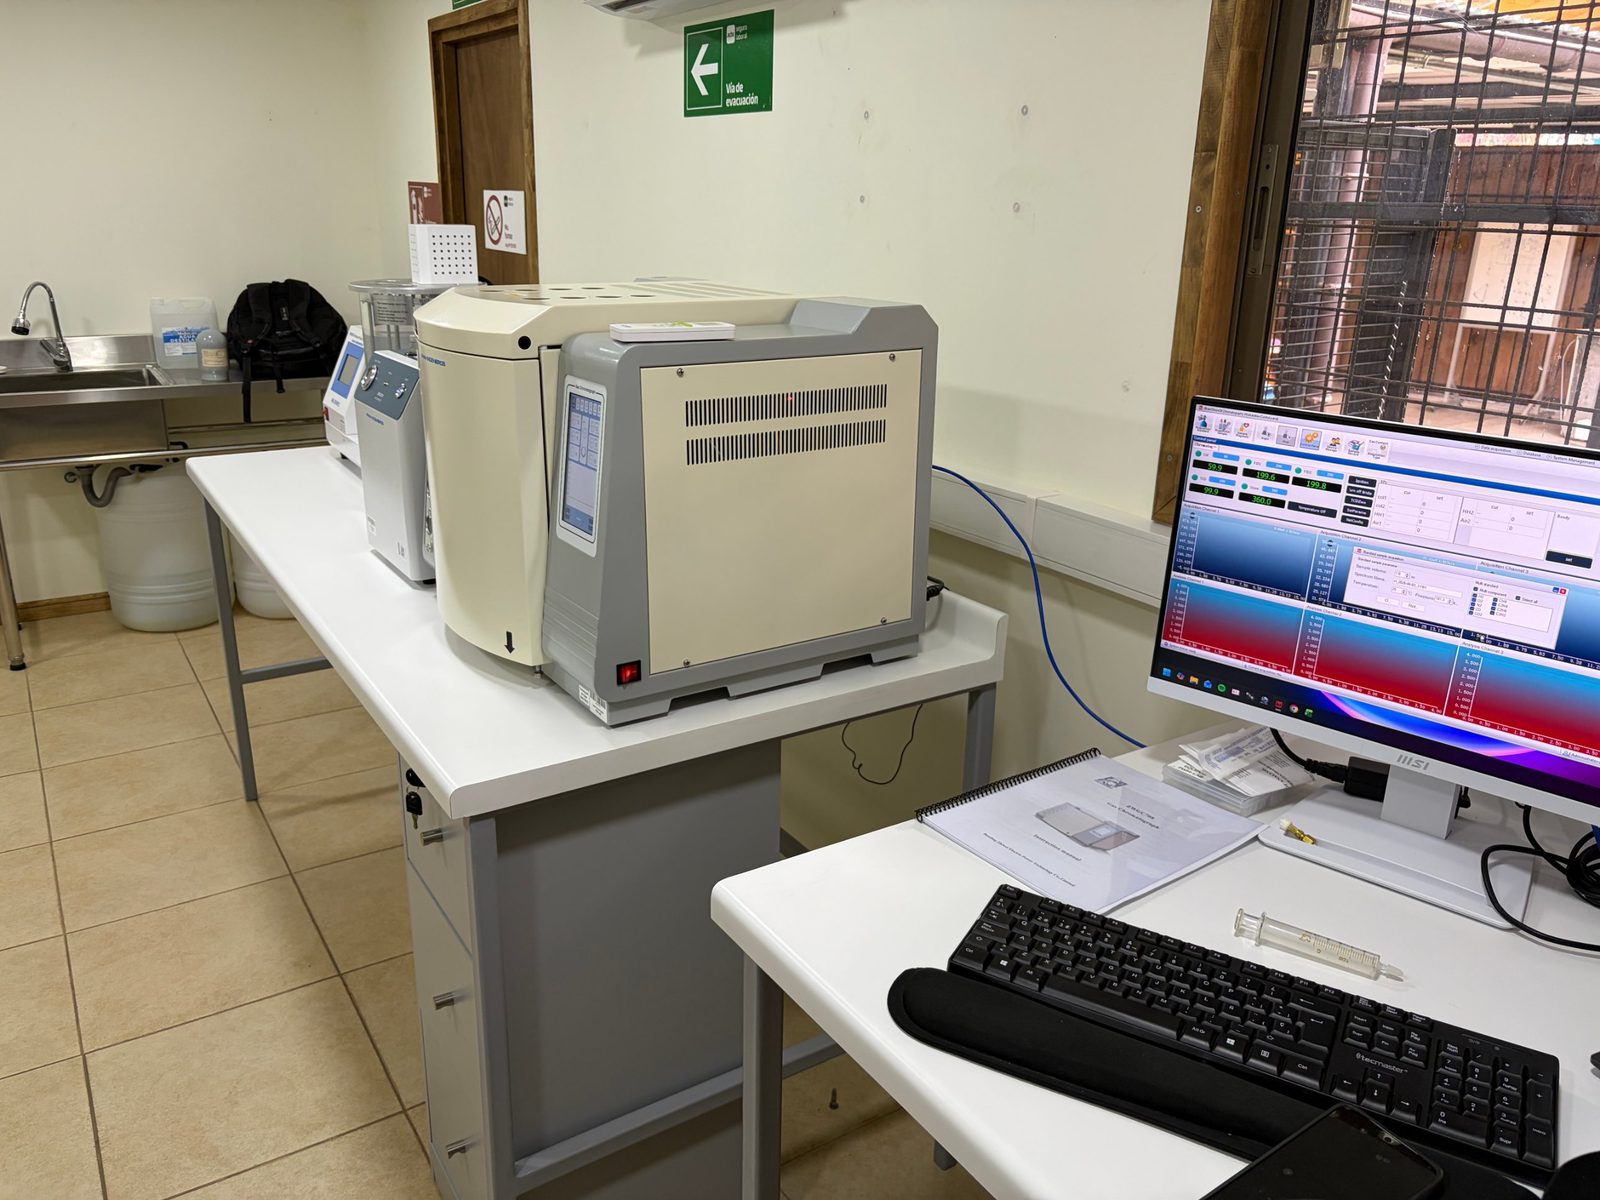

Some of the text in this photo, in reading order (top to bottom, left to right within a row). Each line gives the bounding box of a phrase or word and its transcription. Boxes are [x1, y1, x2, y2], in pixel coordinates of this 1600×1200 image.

[726, 82, 744, 94] Vía de
[726, 93, 758, 107] evacuación
[1208, 462, 1222, 472] 59.9
[1256, 472, 1276, 480] 199.6
[1306, 480, 1327, 490] 199.8
[1204, 487, 1219, 496] 99.9
[1252, 496, 1272, 504] 360.0
[1480, 560, 1504, 570] Acquisition
[1505, 565, 1524, 573] Channel
[1480, 645, 1500, 653] Channel
[1360, 1054, 1404, 1074] tecmaster
